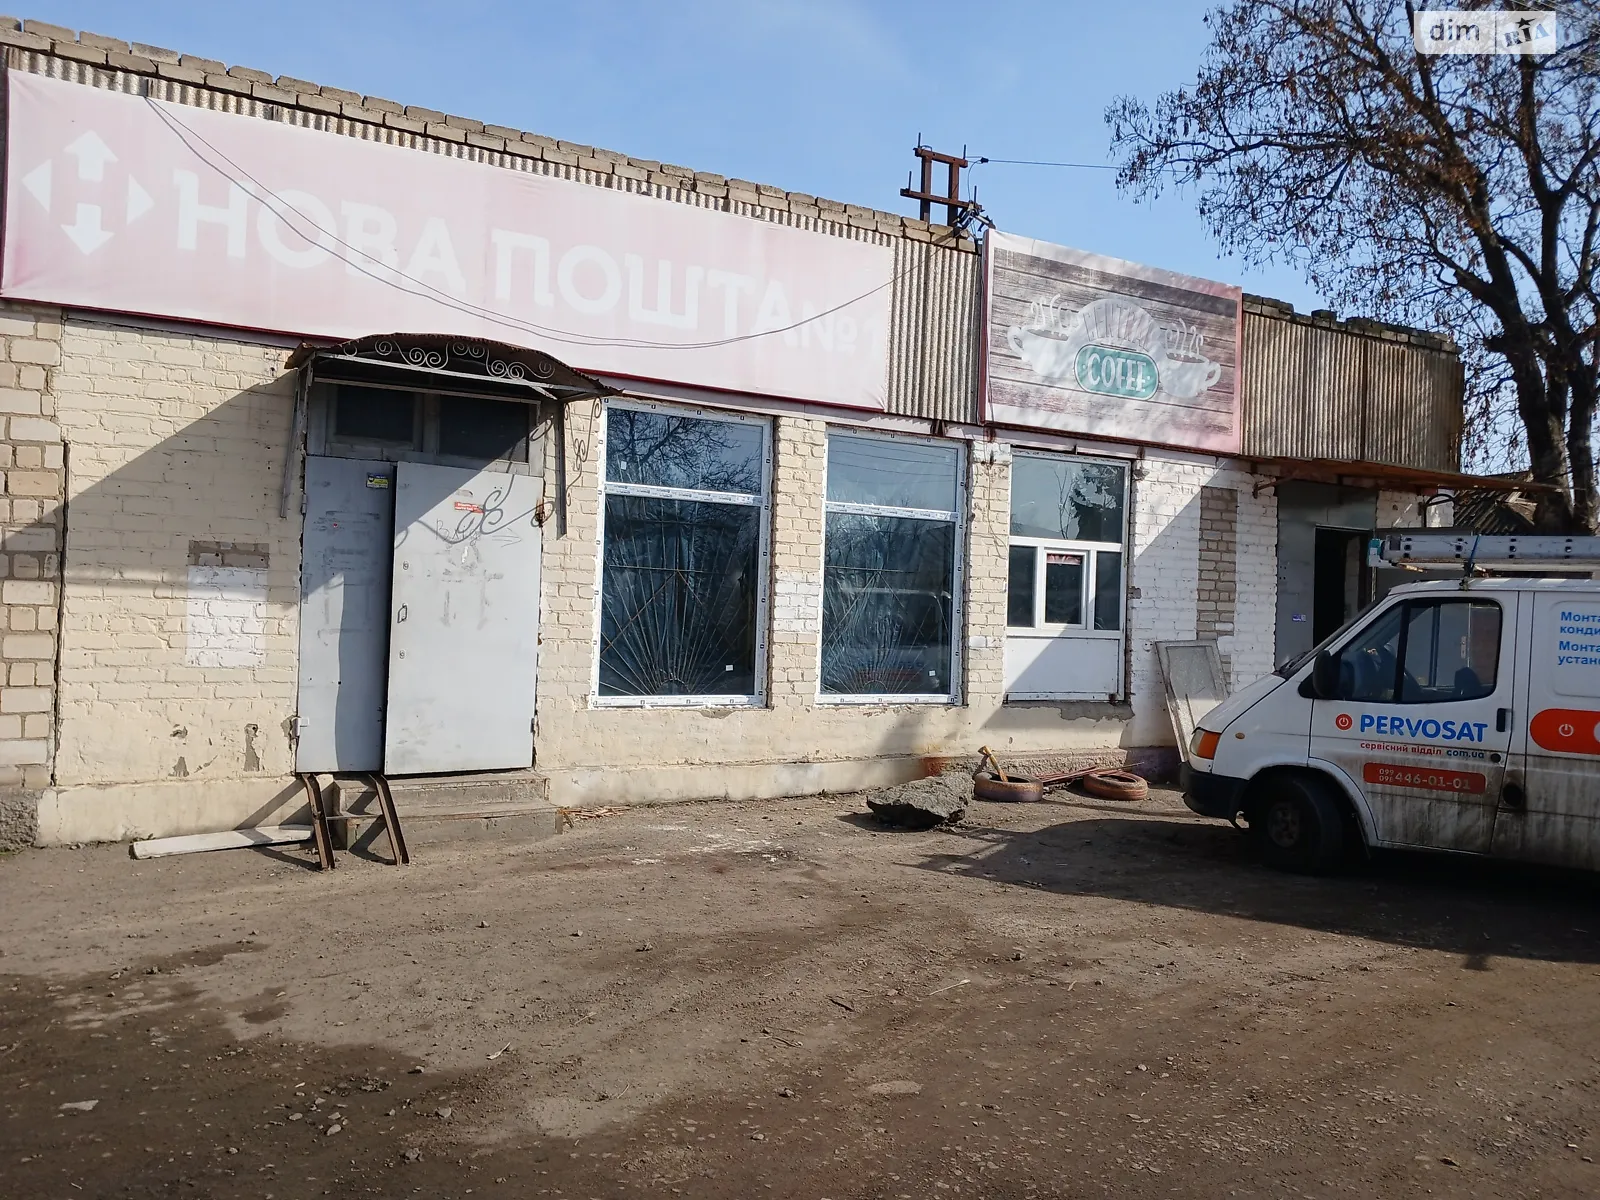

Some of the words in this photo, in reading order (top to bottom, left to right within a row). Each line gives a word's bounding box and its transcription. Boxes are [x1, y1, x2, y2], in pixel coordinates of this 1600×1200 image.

[172, 167, 467, 293] НОВА
[491, 226, 798, 348] ПОШТА
[1360, 713, 1489, 743] PERVOSAT
[1360, 742, 1409, 753] сервісний
[1411, 746, 1442, 756] відділ
[1446, 749, 1485, 760] com.ua
[1395, 772, 1471, 790] 446-01-01
